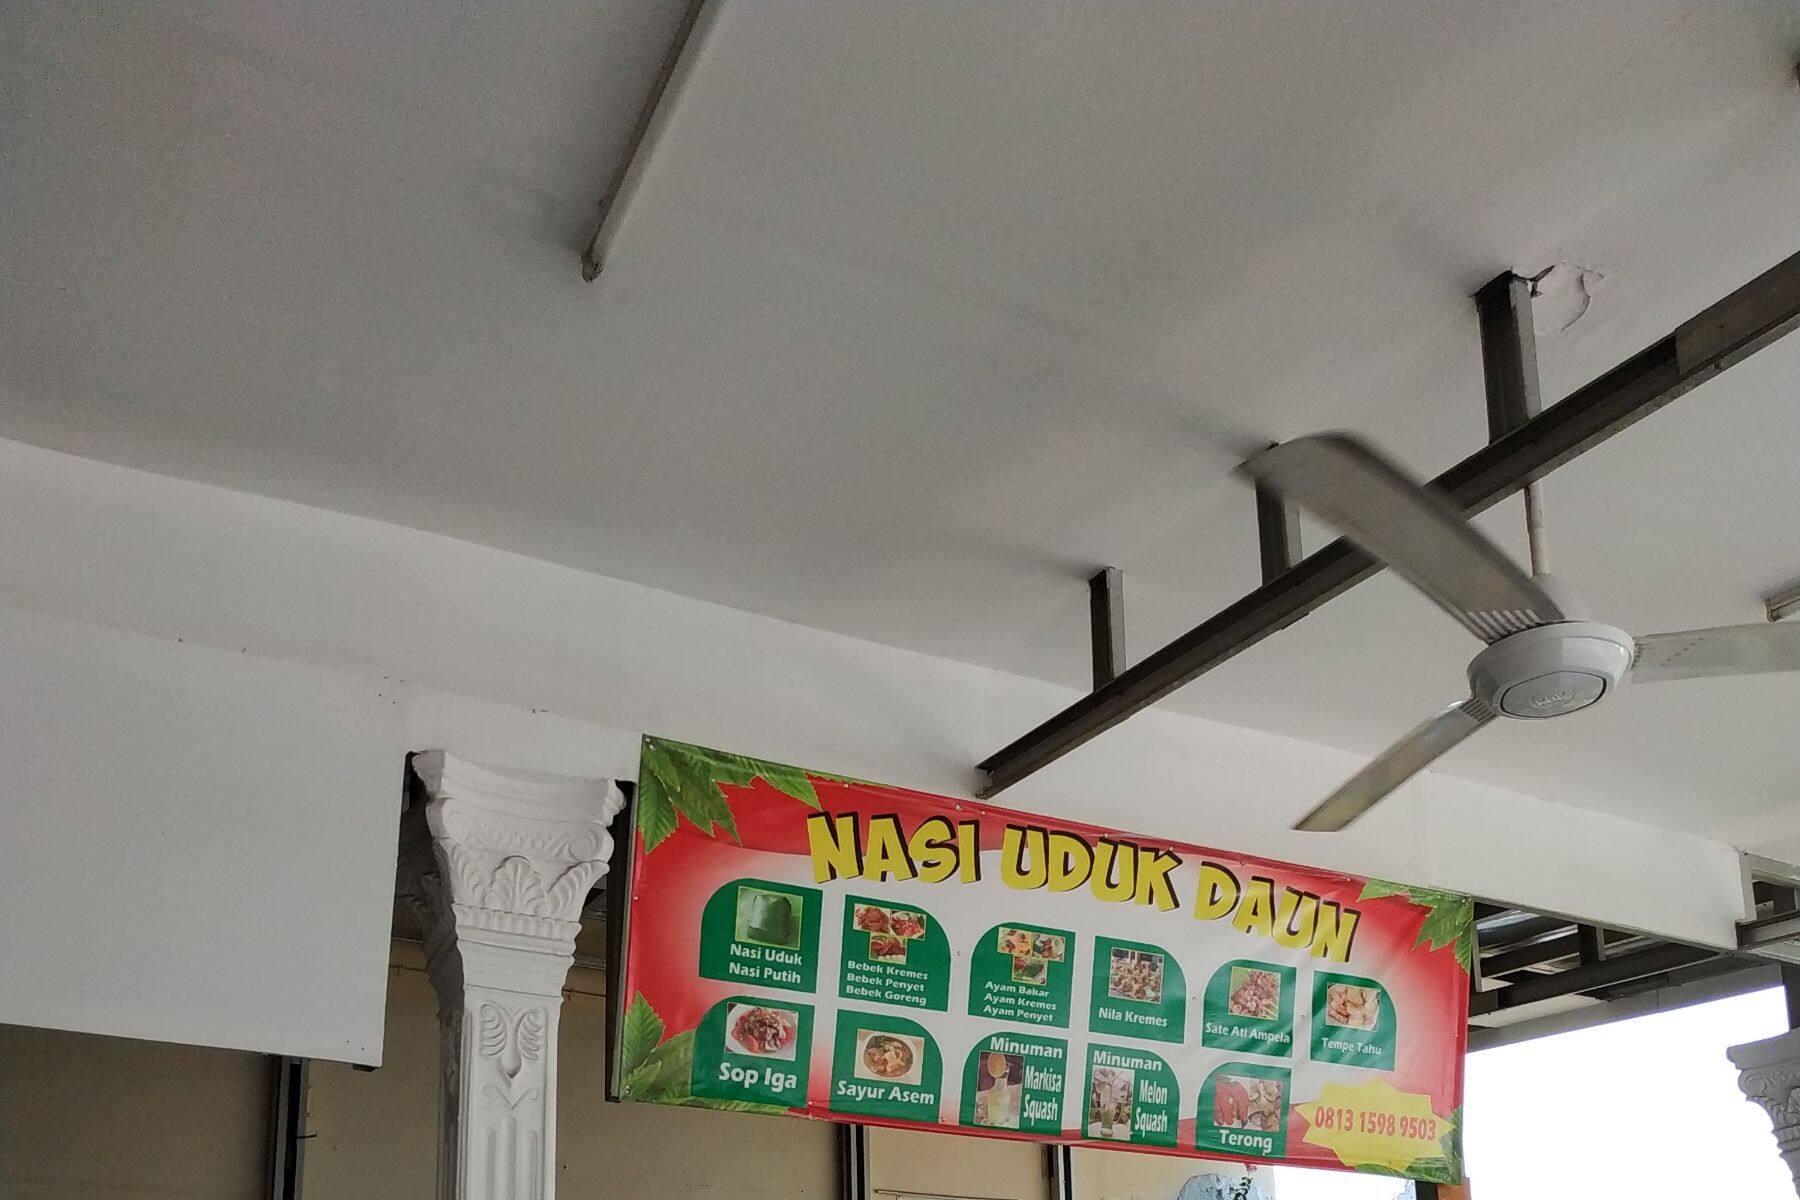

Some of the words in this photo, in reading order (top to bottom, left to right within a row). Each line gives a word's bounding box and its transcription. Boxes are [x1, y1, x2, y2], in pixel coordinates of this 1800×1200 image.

[806, 812, 981, 883] NASI
[999, 824, 1183, 912] UDUK
[1193, 860, 1361, 963] DAUN
[730, 944, 761, 959] Nasi
[765, 947, 802, 965] Uduk
[729, 962, 760, 978] Nasi
[764, 968, 801, 984] Putih
[848, 960, 883, 974] Bebek
[886, 965, 928, 980] Kremes
[847, 972, 883, 986] Bebek
[885, 978, 924, 993] Penyet
[985, 980, 1016, 994] Ayam
[1018, 986, 1050, 998] Bakar
[846, 985, 882, 999] Bebek
[885, 990, 927, 1006] Goreng
[984, 993, 1015, 1006] Ayam
[1017, 997, 1057, 1011] Kremes
[983, 1004, 1014, 1018] Ayam
[1016, 1009, 1054, 1022] Penyet
[1098, 1007, 1122, 1021] Nila
[1125, 1011, 1168, 1027] Kremes
[1205, 1022, 1230, 1036] Sate
[1231, 1025, 1248, 1038] Ati
[1249, 1028, 1290, 1046] Ampela
[990, 1036, 1063, 1059] Minuman
[1321, 1037, 1355, 1054] Tempe
[1357, 1042, 1382, 1055] Tahu
[1093, 1050, 1162, 1071] Minuman
[718, 1062, 759, 1089] Sop
[764, 1068, 797, 1092] Iga
[1025, 1065, 1062, 1092] Markisa
[837, 1080, 885, 1100] Sayur
[888, 1086, 934, 1105] Asem
[1139, 1079, 1168, 1105] Melon
[1023, 1093, 1058, 1126] Squash
[1135, 1107, 1168, 1137] Squash
[1315, 1106, 1353, 1132] 0813
[1360, 1111, 1395, 1136] 1598
[1400, 1118, 1437, 1141] 9503
[1220, 1129, 1273, 1156] Terong
